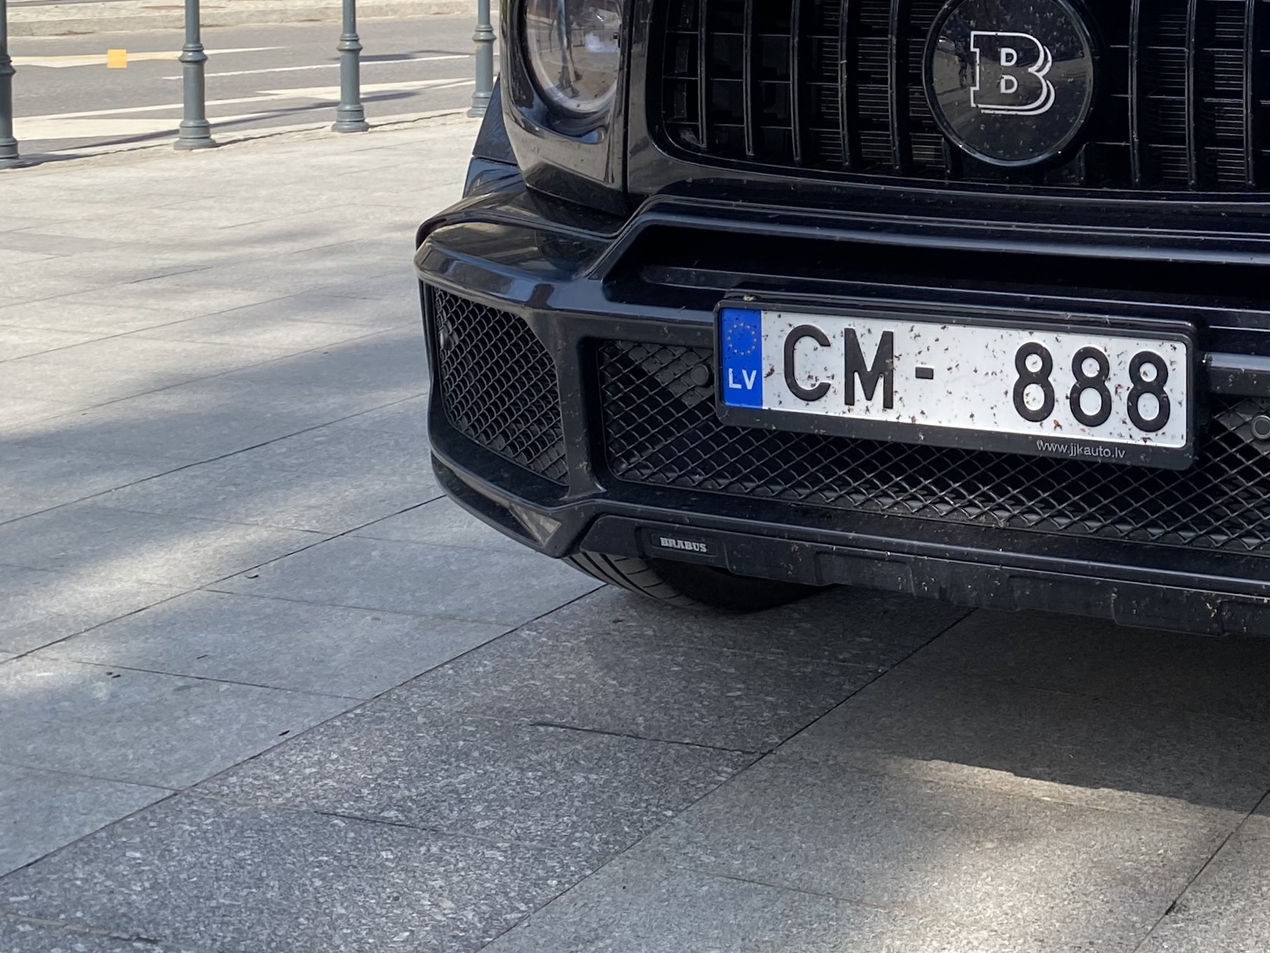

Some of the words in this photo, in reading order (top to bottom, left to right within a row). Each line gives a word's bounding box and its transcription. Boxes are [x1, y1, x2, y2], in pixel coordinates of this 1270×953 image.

[728, 367, 758, 390] LV
[1012, 341, 1171, 433] 888
[660, 536, 707, 553] BRABUS
